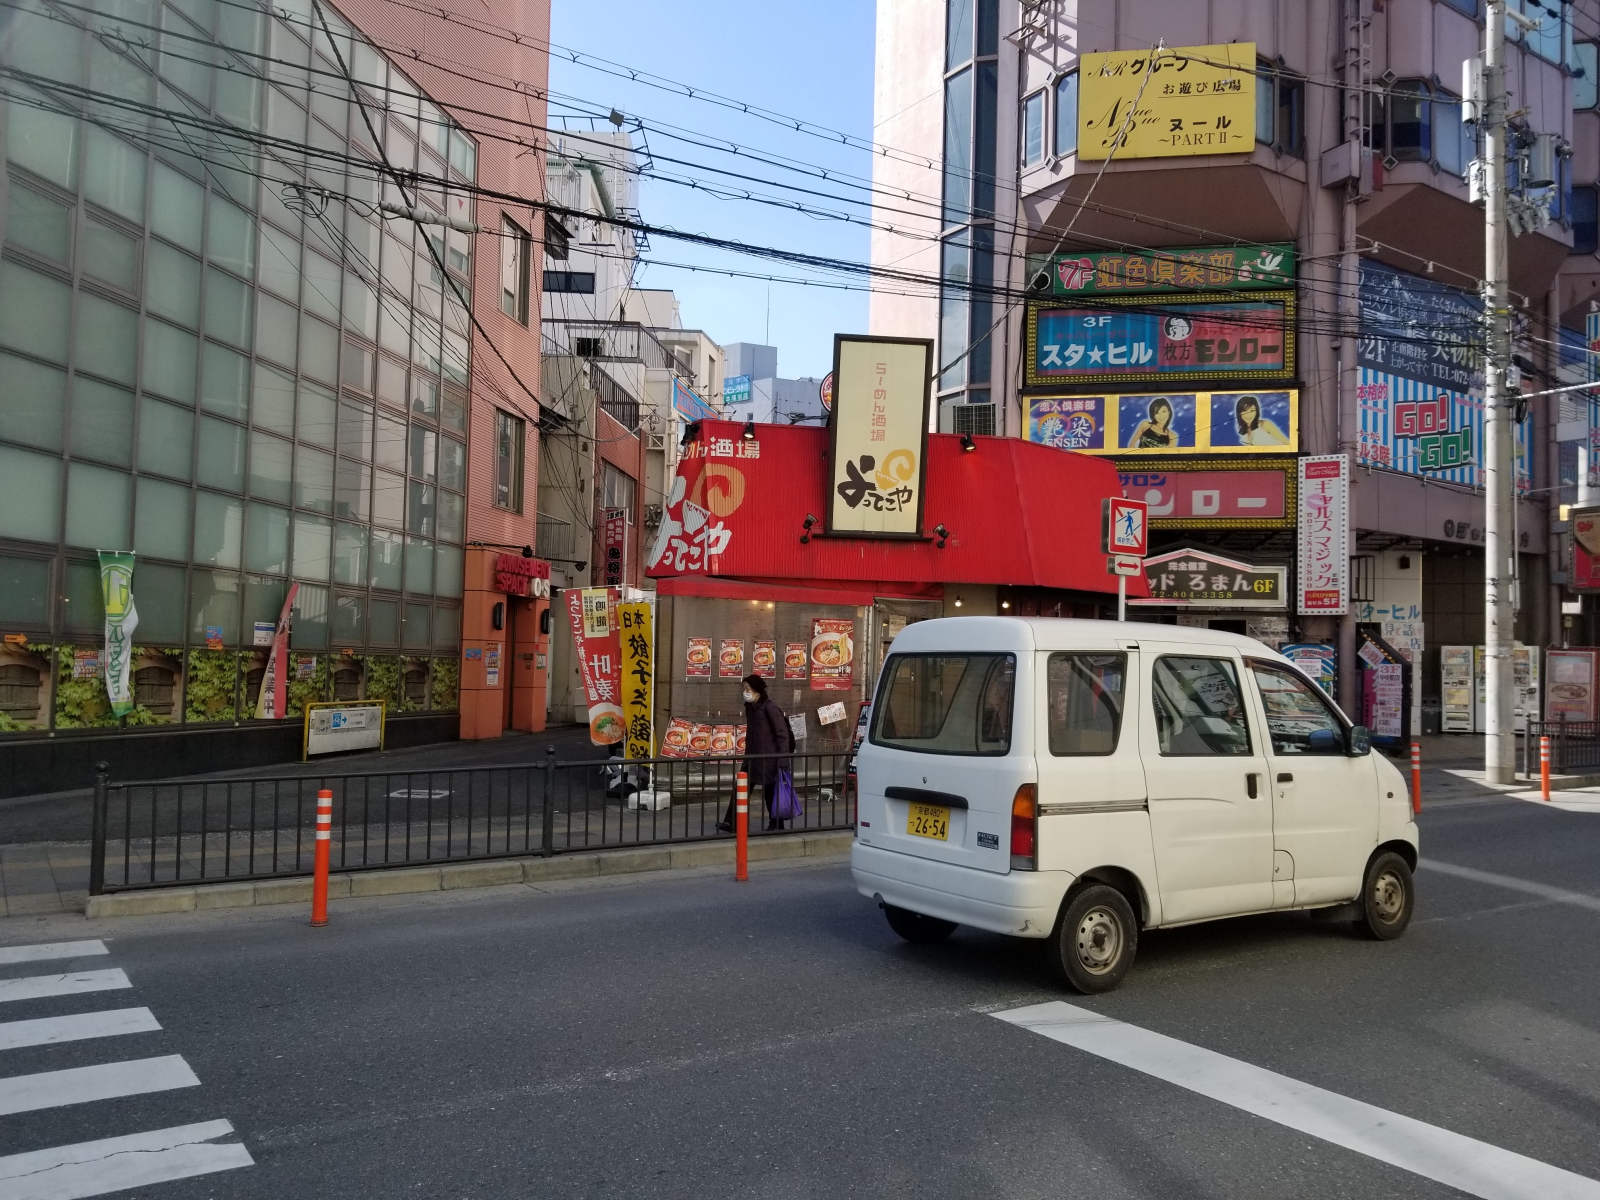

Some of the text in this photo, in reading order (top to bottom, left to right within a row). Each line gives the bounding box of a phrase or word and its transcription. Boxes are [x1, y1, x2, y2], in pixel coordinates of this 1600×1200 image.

[1163, 79, 1242, 95] お遊び広場
[1169, 116, 1232, 132] ヌール
[1058, 252, 1236, 290] 7F 虹色倶楽部
[1082, 316, 1113, 328] 3F
[1163, 338, 1281, 363] 枚方 モンロー
[1389, 357, 1429, 377] 上がってすぐ
[1357, 382, 1389, 401] 本格的
[1039, 400, 1096, 412] 恋人倶楽部
[1395, 395, 1448, 437] GO!
[1045, 437, 1090, 448] ENSEN
[1419, 426, 1471, 469] GO!
[836, 454, 914, 513] よってこや
[1123, 489, 1267, 516] ンロー
[496, 553, 551, 579] AMUSEMENT
[1168, 561, 1208, 572] 完全個室
[496, 573, 529, 596] SPACE
[1188, 573, 1252, 592] ろまん
[1253, 579, 1275, 593] 6F
[915, 817, 947, 838] 26-54
